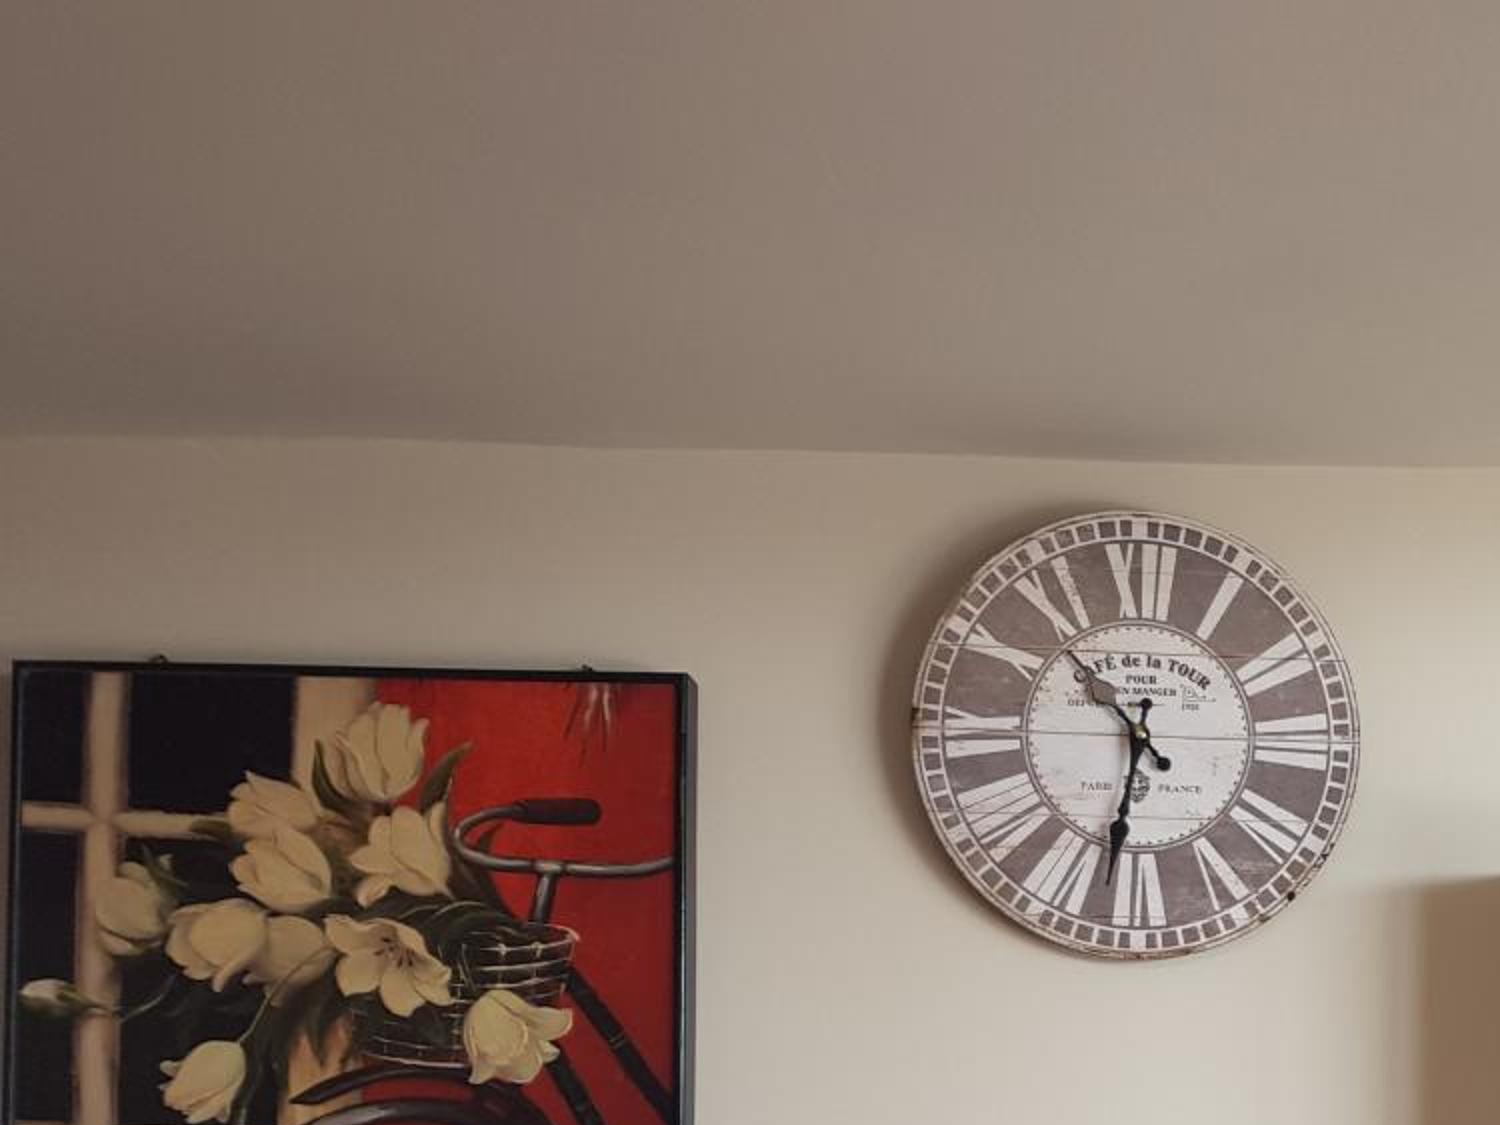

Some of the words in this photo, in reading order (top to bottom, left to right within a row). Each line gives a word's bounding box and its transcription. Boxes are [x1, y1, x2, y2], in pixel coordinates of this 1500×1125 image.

[1013, 555, 1092, 641] XI
[1105, 543, 1177, 621] XII
[961, 623, 1046, 681] X
[1120, 655, 1141, 669] de
[1145, 655, 1162, 669] la
[1168, 659, 1211, 691] TOUR
[1125, 675, 1157, 685] POUR
[1158, 783, 1202, 794] FRANCE
